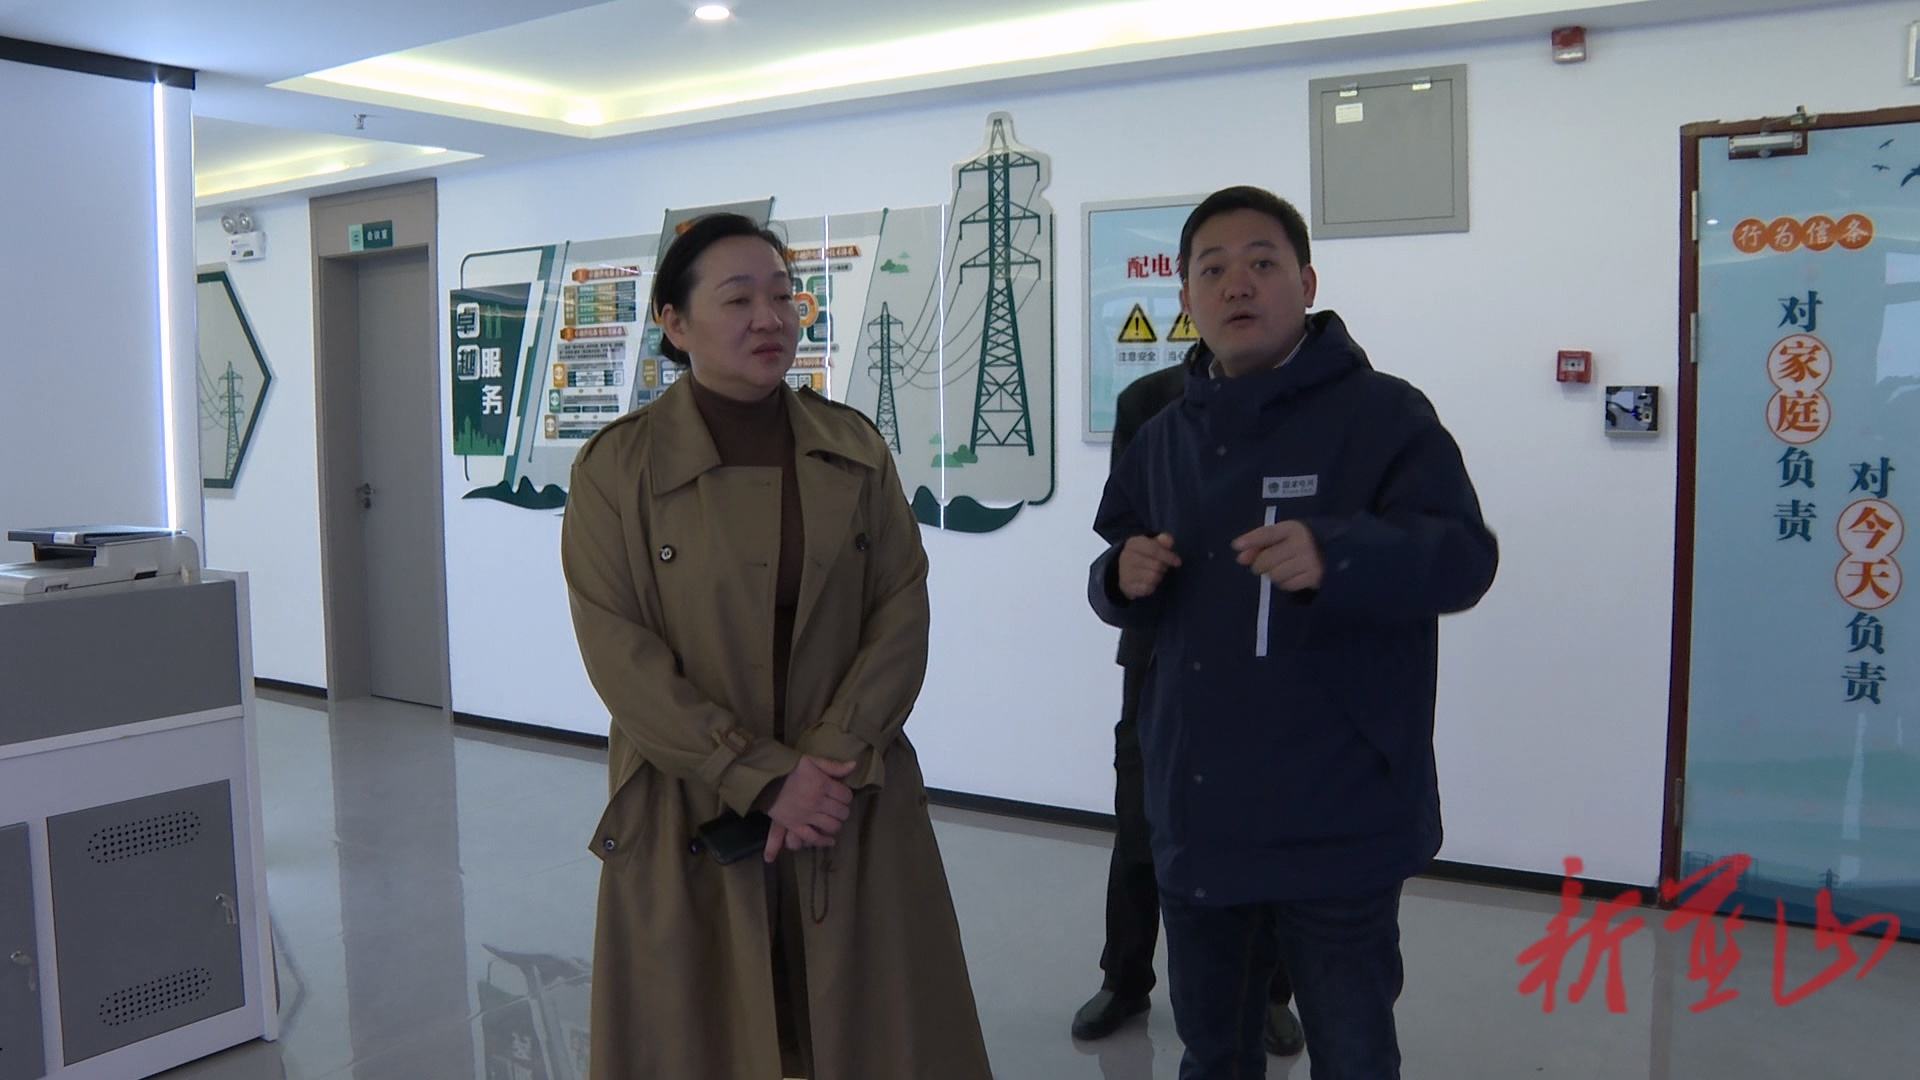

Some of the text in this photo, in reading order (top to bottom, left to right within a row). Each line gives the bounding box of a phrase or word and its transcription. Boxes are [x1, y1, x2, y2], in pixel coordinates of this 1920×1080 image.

[1738, 219, 1869, 247] 行为信条
[457, 303, 479, 379] 卓越
[1118, 351, 1156, 362] 注意安全
[481, 347, 502, 415] 服务
[1774, 290, 1823, 542] 对家庭负责
[1841, 456, 1896, 705] 对今天负责
